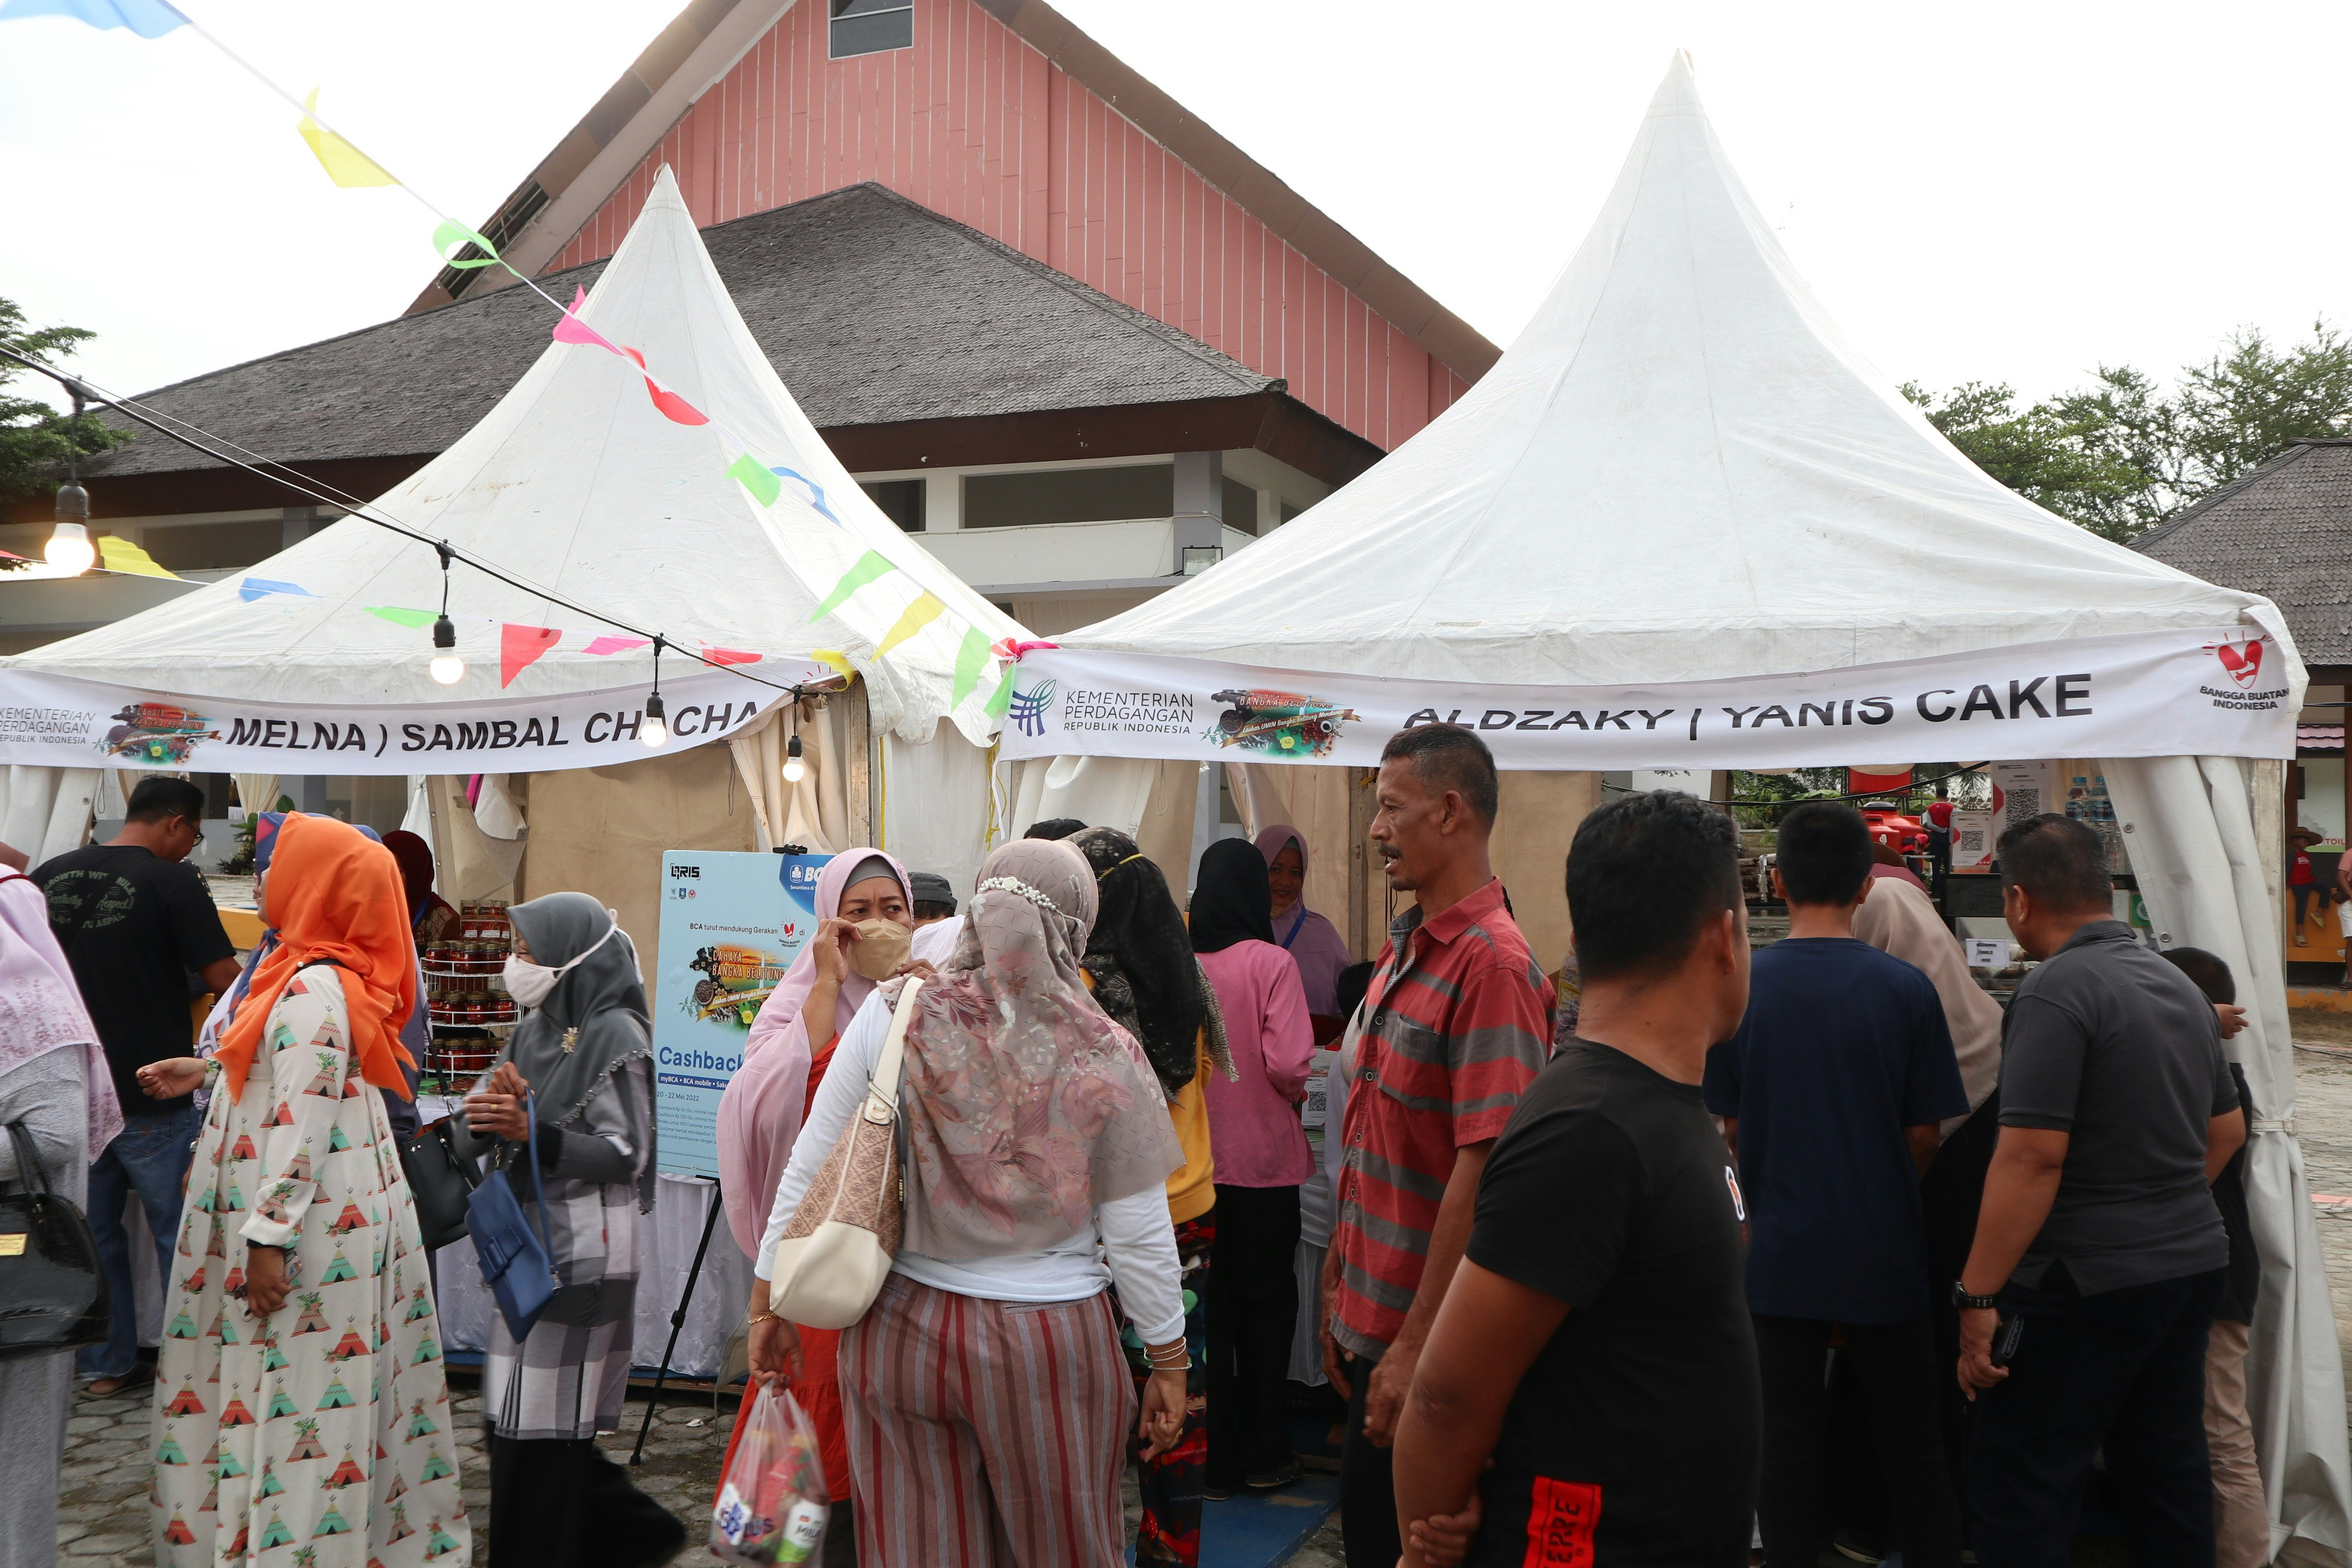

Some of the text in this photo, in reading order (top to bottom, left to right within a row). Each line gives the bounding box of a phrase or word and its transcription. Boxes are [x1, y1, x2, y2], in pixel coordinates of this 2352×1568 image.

[1066, 690, 1194, 708] KEMENTERIAN
[2200, 685, 2289, 701] BANGGA BUATAN
[1239, 695, 1334, 709] BANGKA BELITUNG
[1403, 708, 1675, 730] ALDZAKY
[1721, 697, 1894, 729] YANIS
[1916, 673, 2093, 721] CAKE
[2213, 698, 2278, 710] INDONESIA
[136, 707, 165, 717] CAHAYA
[1064, 705, 1194, 723] PERDAGANGAN
[132, 717, 205, 731] BANGKA BELITUNG
[1063, 722, 1191, 735] REPUBLIK INDONESIA
[1242, 710, 1345, 734] Laskar UMKM Bangka Belitung Mendunia
[226, 717, 366, 751] MELNA
[401, 716, 569, 752] SAMBAL
[583, 710, 668, 744] CH
[0, 734, 86, 744] EPUBLIK INDONESIA
[44, 870, 85, 890] GROWTH
[671, 865, 701, 880] QRIS
[96, 913, 126, 928] ASPAL
[718, 925, 752, 935] mendukung
[713, 949, 742, 963] CAHAYA
[712, 963, 784, 981] BANGKA BELITUNG
[713, 995, 727, 1005] Laskar
[727, 993, 740, 1002] UMKM
[741, 991, 756, 1000] Bangka
